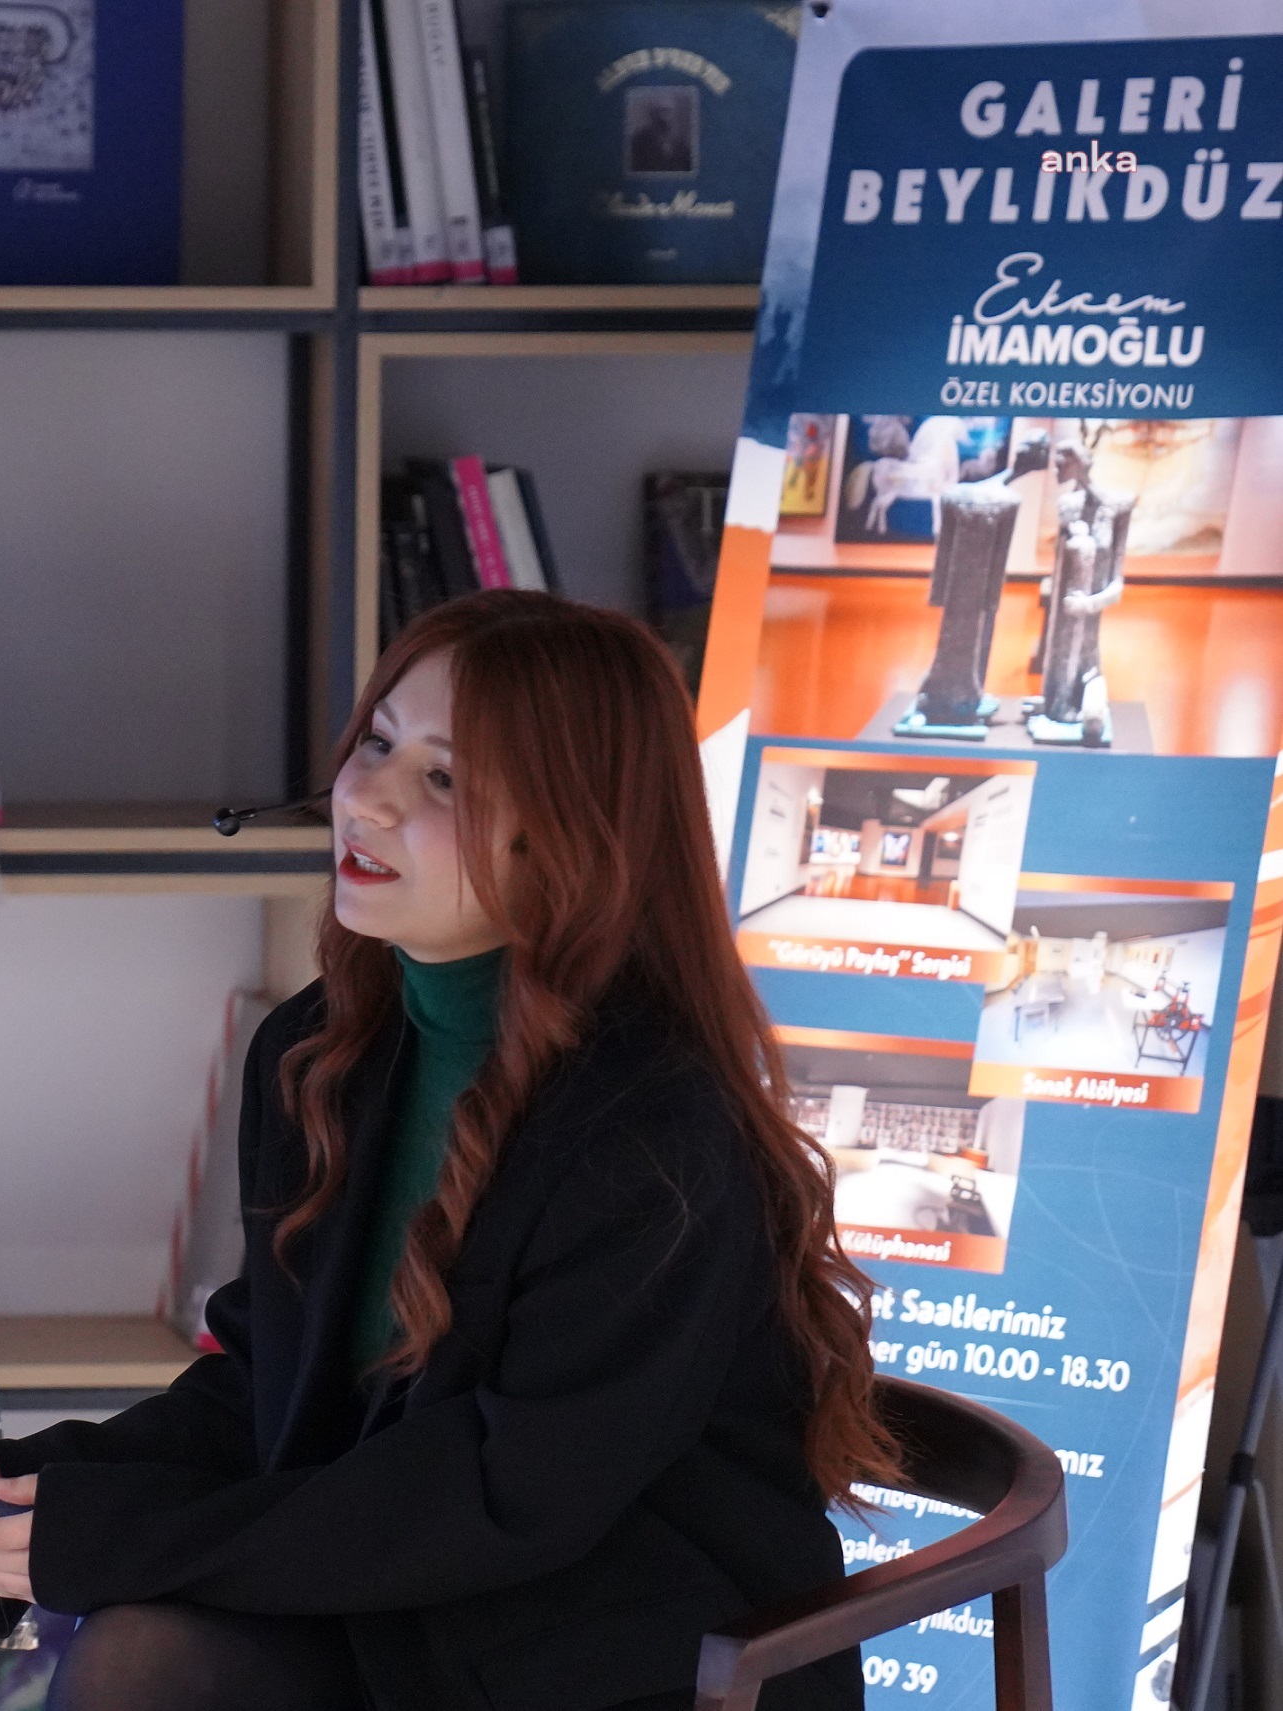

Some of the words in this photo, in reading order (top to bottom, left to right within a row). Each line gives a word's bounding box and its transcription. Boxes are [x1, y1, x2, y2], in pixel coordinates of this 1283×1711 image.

[961, 57, 1243, 138] GALERİ
[946, 315, 1204, 366] İMAMOĞLU
[939, 376, 1001, 406] ÖZEL
[1009, 376, 1195, 408] KOLEKSİYONU
[1021, 1072, 1074, 1098] Sanat
[1074, 1077, 1150, 1107] Atölyesi
[841, 1229, 952, 1262] Kütüphanesi
[899, 1288, 1067, 1341] Saatlerimiz
[905, 1340, 958, 1375] gün
[963, 1342, 1040, 1381] 10.00
[1060, 1354, 1131, 1392] 18.30
[863, 1655, 901, 1687] 09
[901, 1662, 939, 1695] 39
